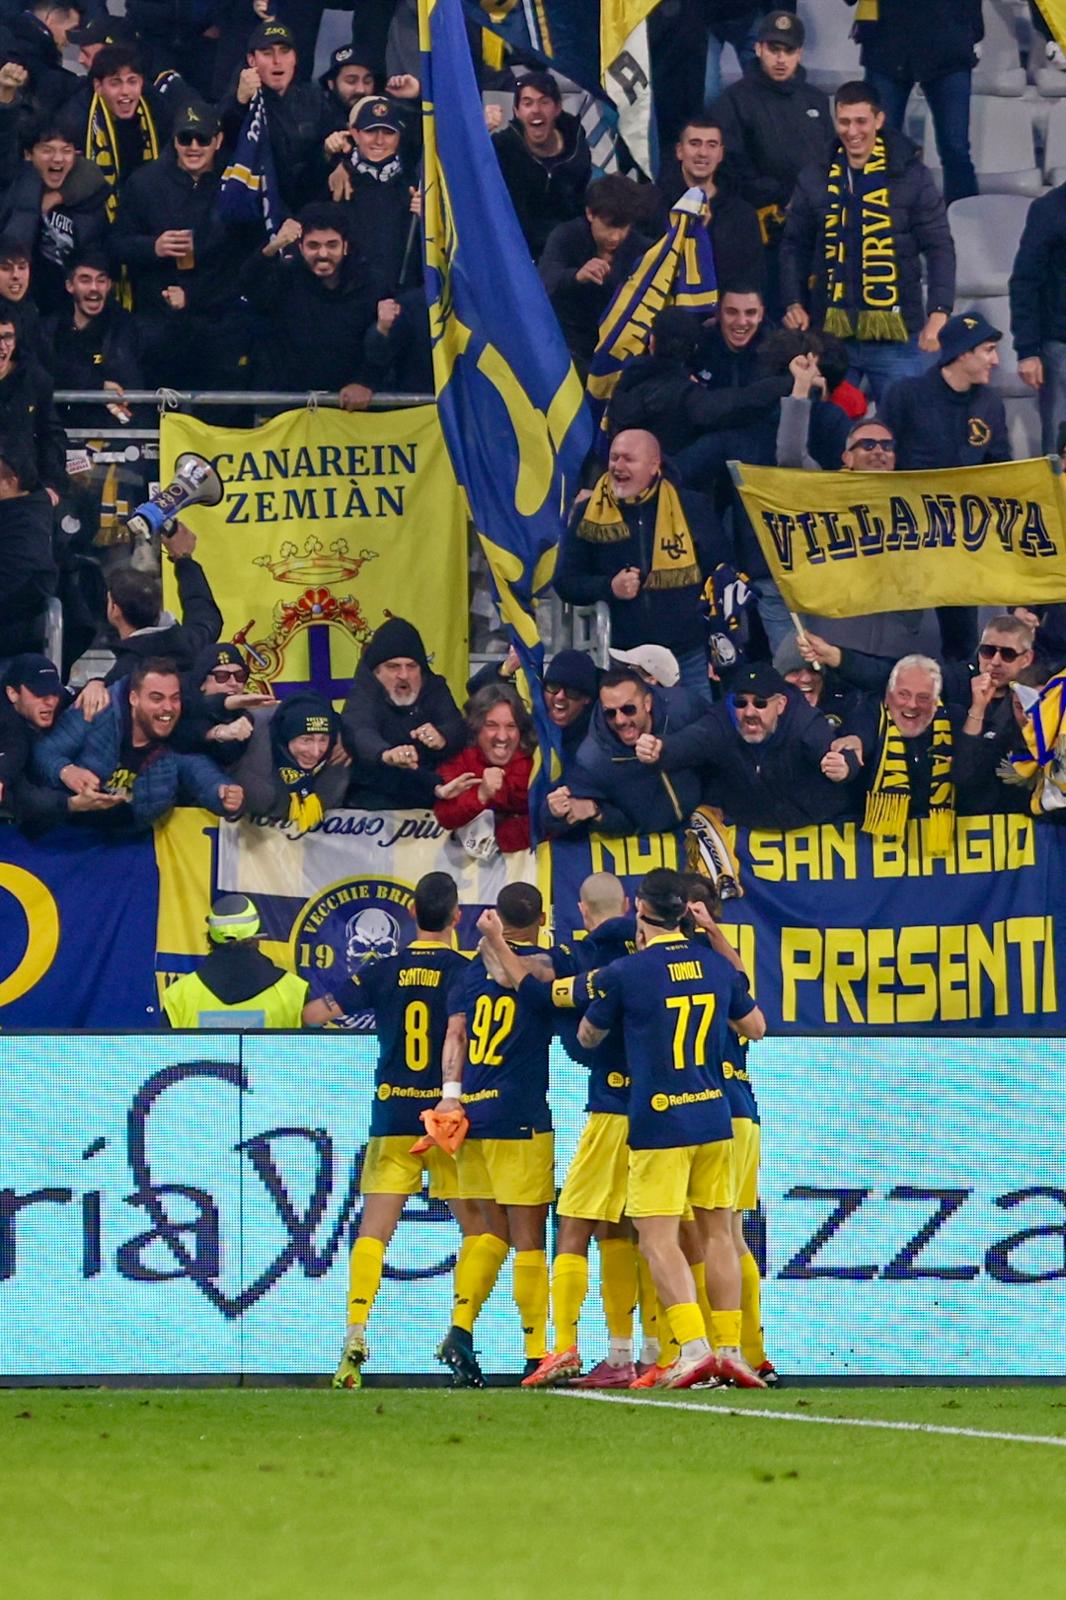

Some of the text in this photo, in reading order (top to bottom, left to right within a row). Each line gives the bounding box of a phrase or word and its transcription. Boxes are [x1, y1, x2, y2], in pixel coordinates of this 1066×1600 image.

[862, 187, 898, 307] CURVA
[209, 443, 418, 483] CANAREIN
[225, 479, 406, 523] ZEMIÀN
[761, 494, 1058, 571] VILLANOVA
[749, 822, 857, 882] SAN
[872, 813, 1036, 879] BIAGIO
[303, 885, 370, 934] VECCHIE
[299, 943, 335, 969] 19
[398, 967, 441, 988] SANTORO
[780, 915, 1058, 1025] PRESENTI
[404, 1000, 429, 1072] 8
[469, 994, 516, 1066] 92
[665, 993, 715, 1070] 77
